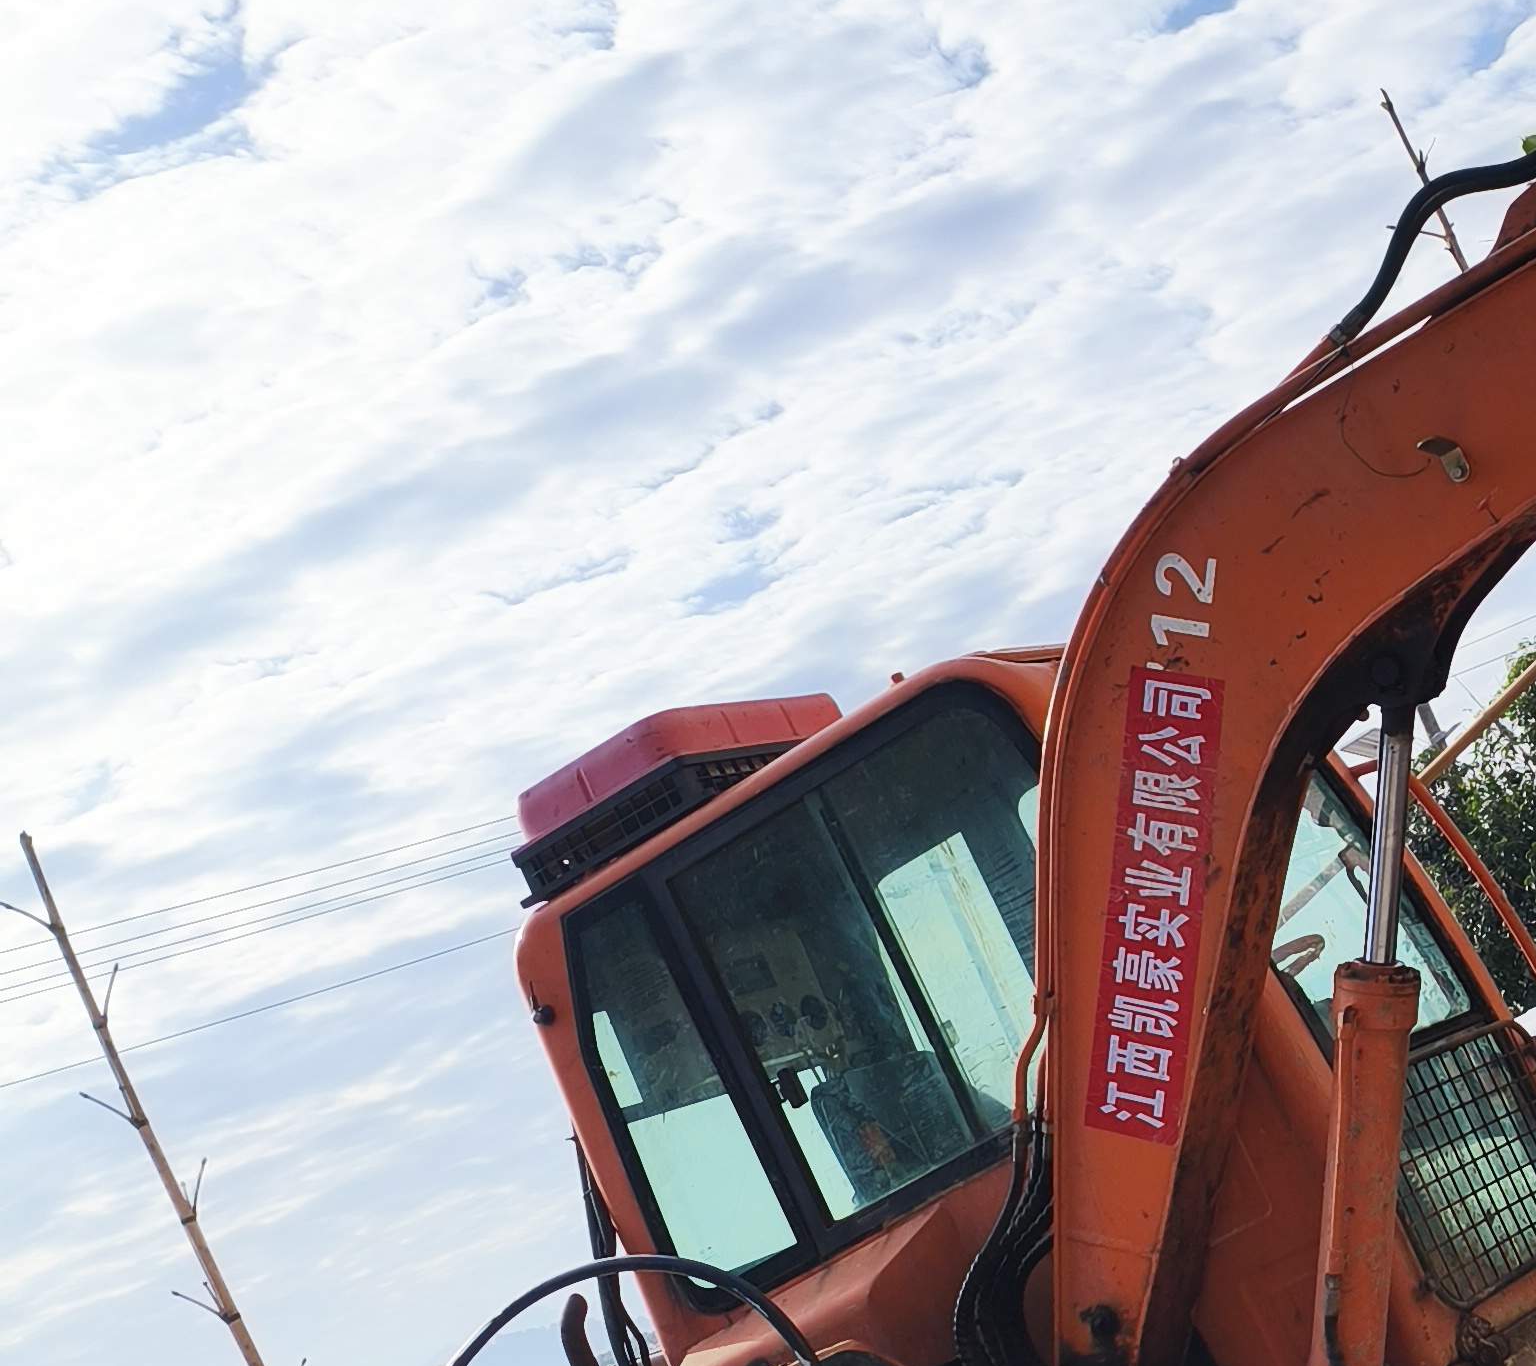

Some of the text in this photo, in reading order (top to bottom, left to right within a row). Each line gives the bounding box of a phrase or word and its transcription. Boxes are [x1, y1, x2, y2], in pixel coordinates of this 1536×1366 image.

[1151, 552, 1217, 649] 12
[1099, 679, 1212, 1129] 江西凯豪实业有限公司
